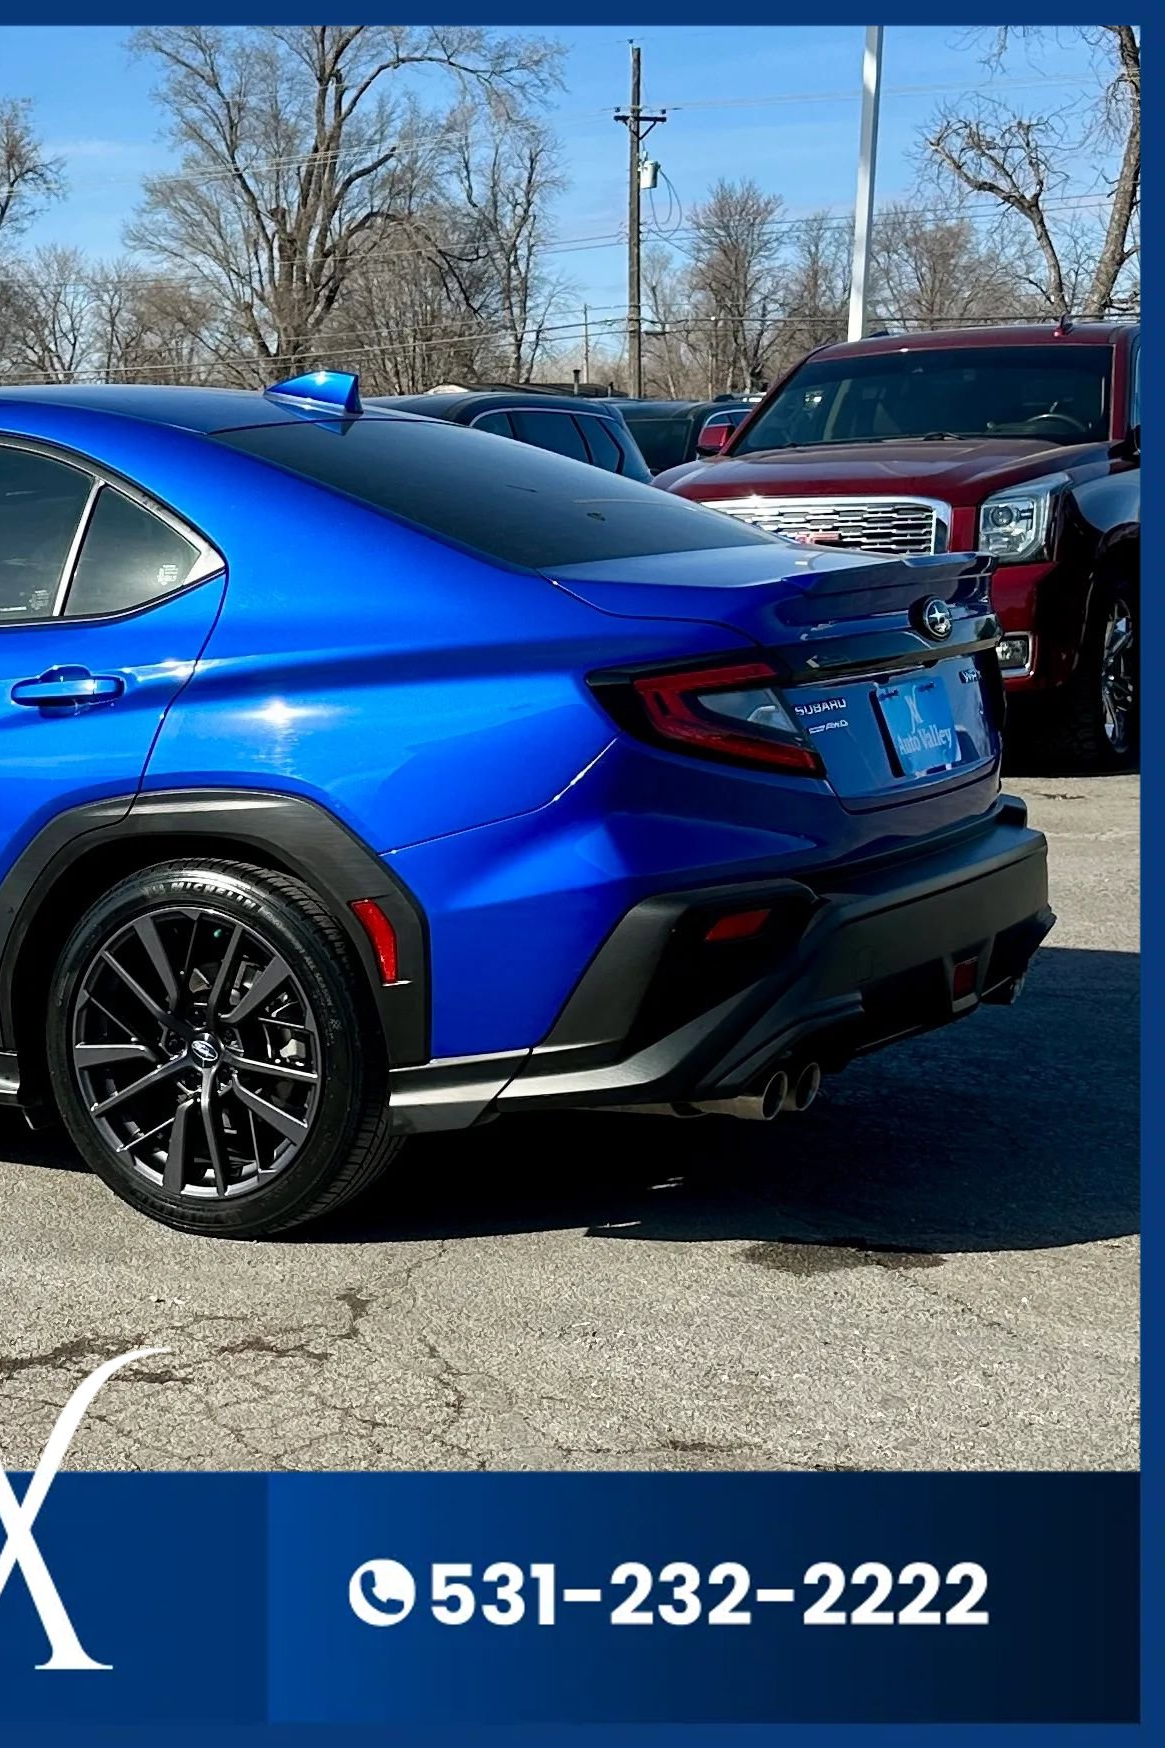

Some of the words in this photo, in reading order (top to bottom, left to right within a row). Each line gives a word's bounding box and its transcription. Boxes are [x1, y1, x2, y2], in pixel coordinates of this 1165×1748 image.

[794, 698, 847, 716] SUBARU
[896, 733, 922, 756] Auto
[916, 722, 953, 749] Valley
